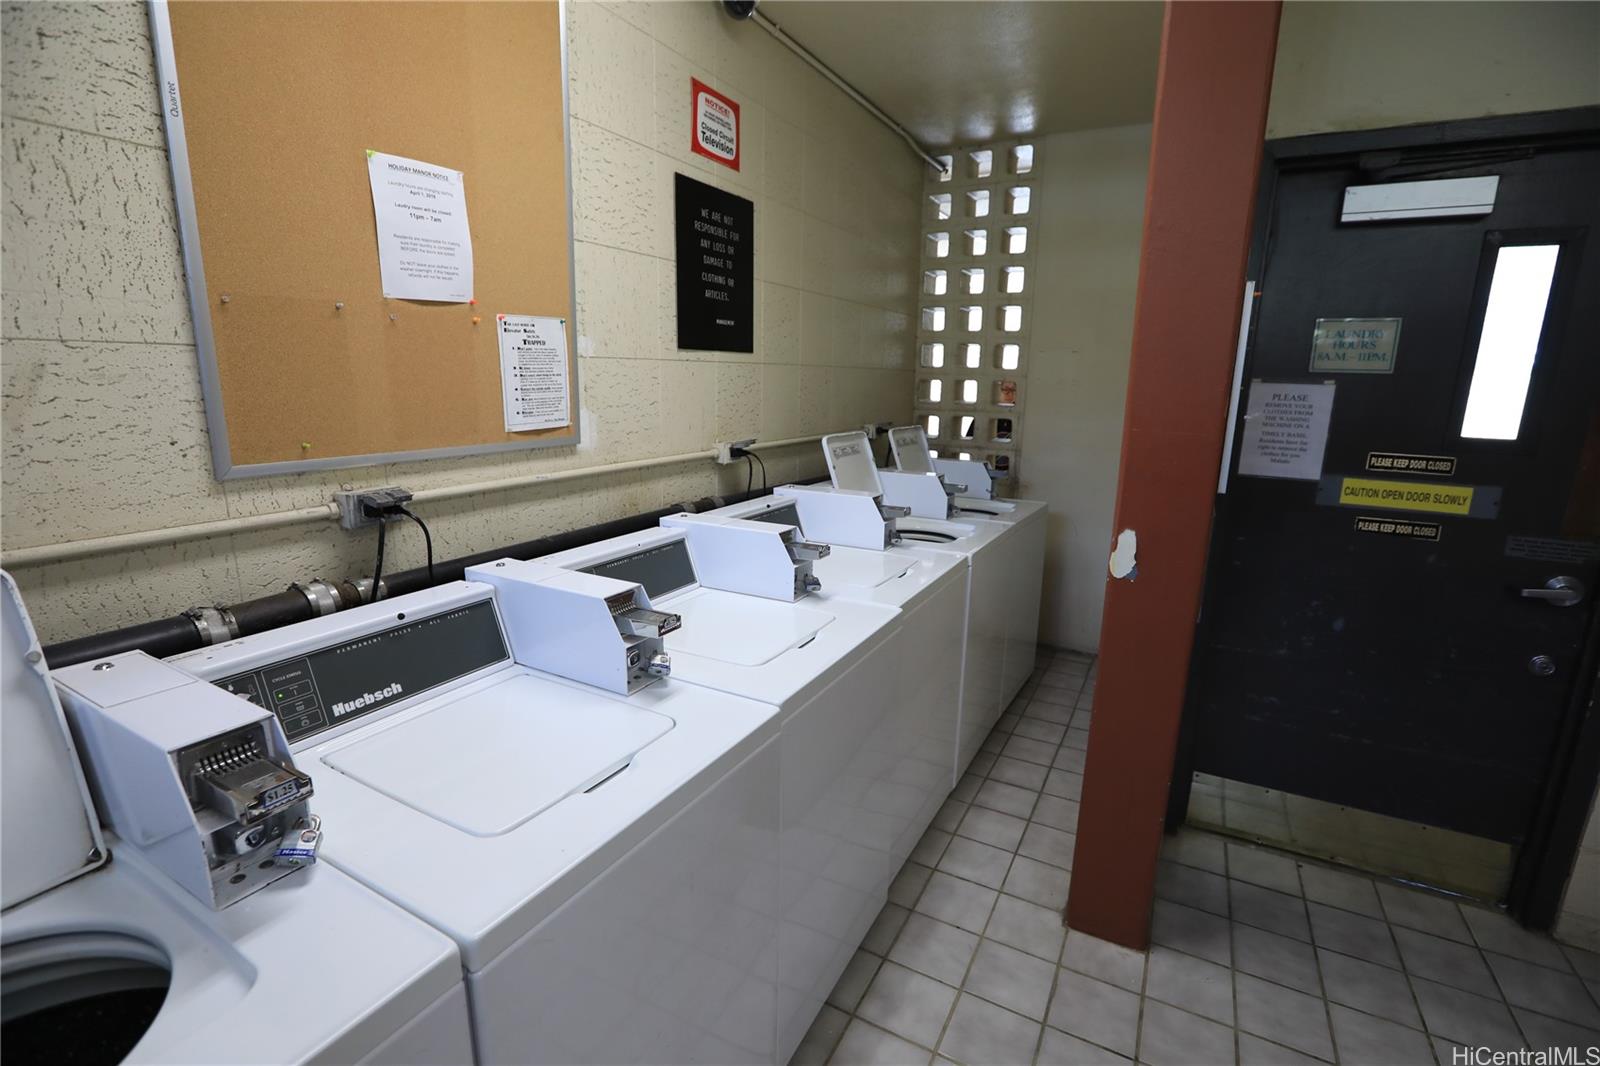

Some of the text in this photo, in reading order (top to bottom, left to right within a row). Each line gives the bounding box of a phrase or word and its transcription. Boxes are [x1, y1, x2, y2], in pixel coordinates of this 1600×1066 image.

[701, 122, 734, 144] Closed Circuit
[701, 130, 734, 156] Television
[388, 162, 449, 182] HOLIDAY MANOR NOTICE
[410, 212, 424, 221] 11pm
[701, 208, 734, 226] WE ARE NOT
[694, 220, 739, 241] RESPONSIBLE FOR
[700, 238, 735, 255] ANY LOSS OR
[703, 254, 733, 270] DAMAGE TO
[702, 272, 734, 287] CLOTHING OR
[1333, 341, 1376, 349] HOURS
[1272, 393, 1309, 402] PLEASE
[1370, 456, 1452, 471] PLEASE KEEP DOOR CLOSED
[1344, 486, 1468, 506] CAUTION OPEN DOOR SLOWLY
[1358, 521, 1436, 536] PLEASE KEEP DOOR CLOSED
[336, 636, 382, 654] PERMANENT
[332, 682, 403, 718] Huebsch
[266, 784, 293, 801] $1.25
